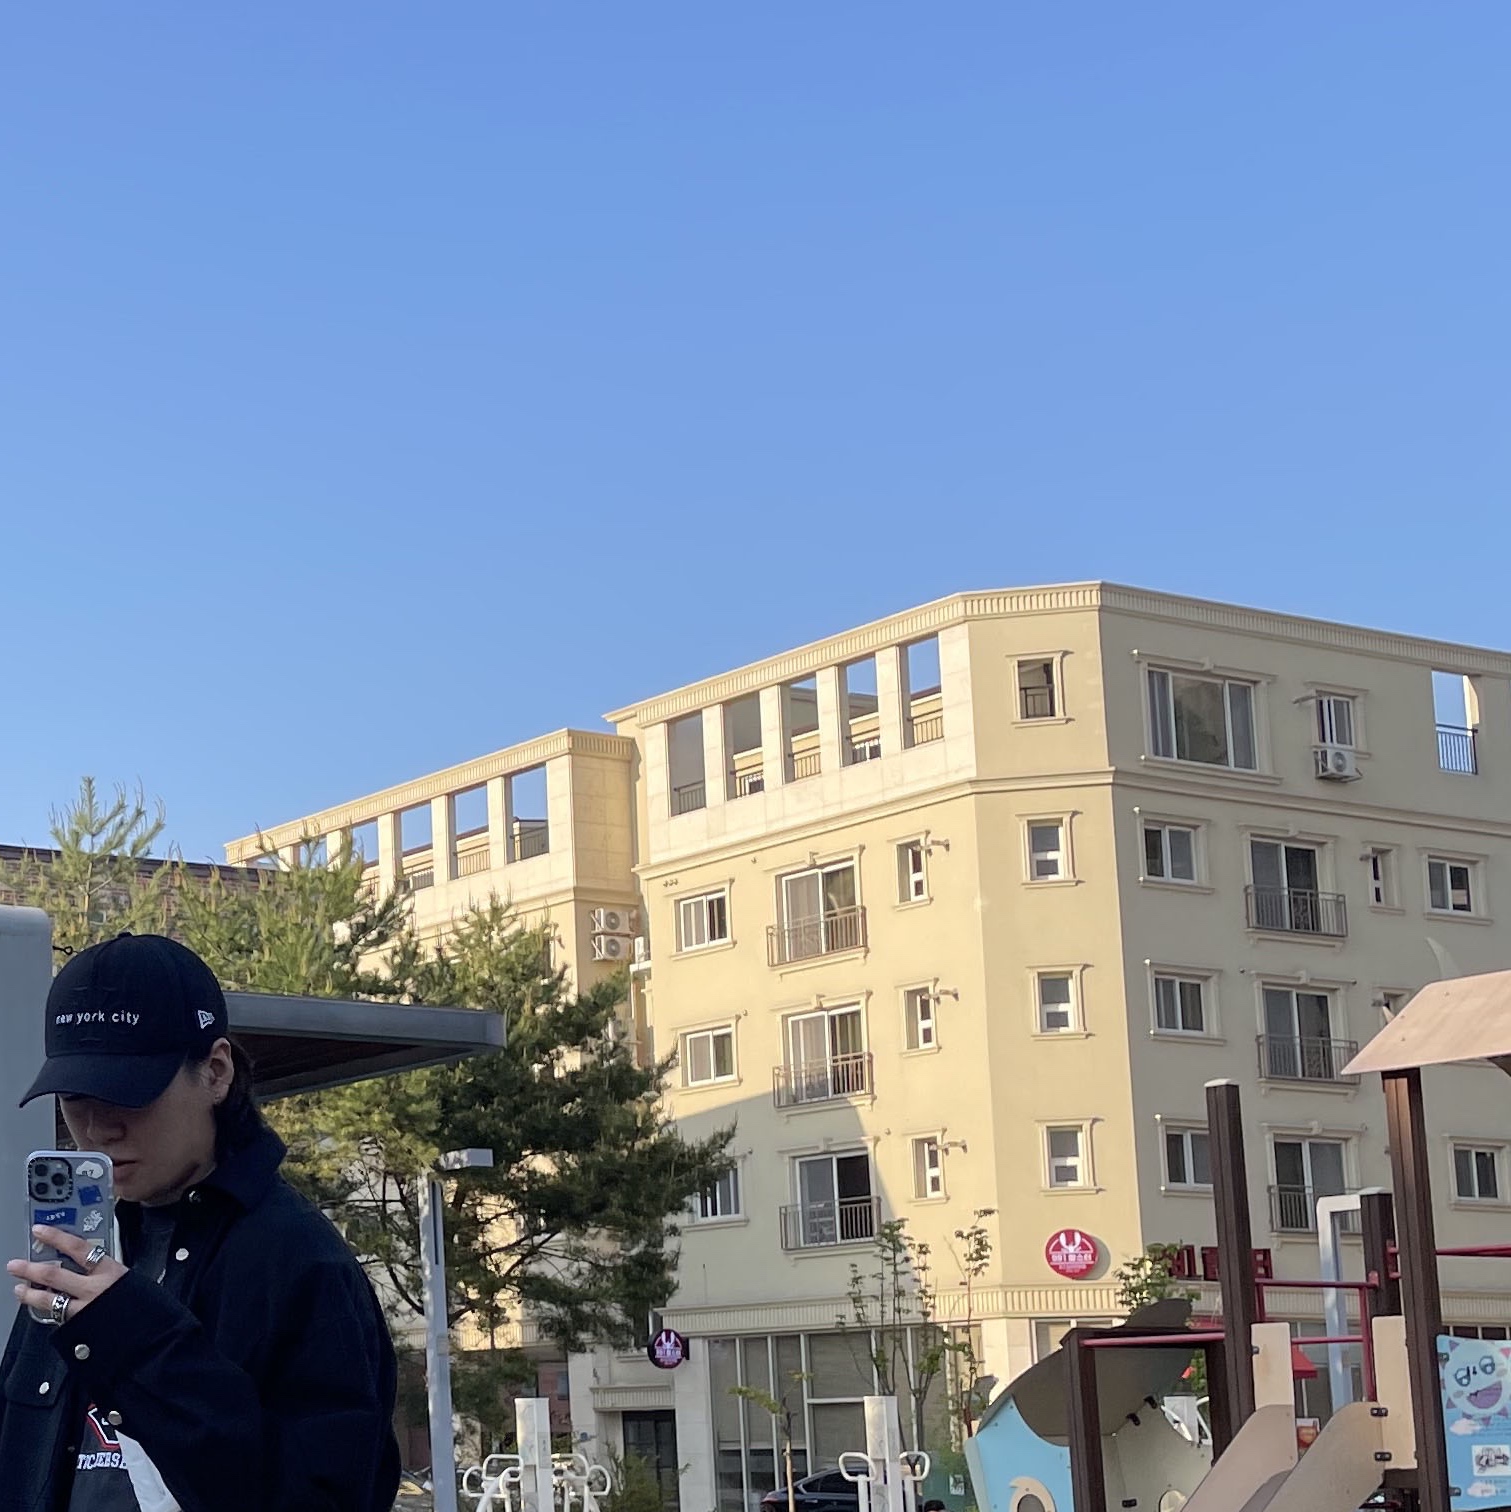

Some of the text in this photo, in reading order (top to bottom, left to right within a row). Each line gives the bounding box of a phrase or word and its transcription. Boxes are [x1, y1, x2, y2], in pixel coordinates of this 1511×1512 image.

[55, 1009, 140, 1026] new york city
